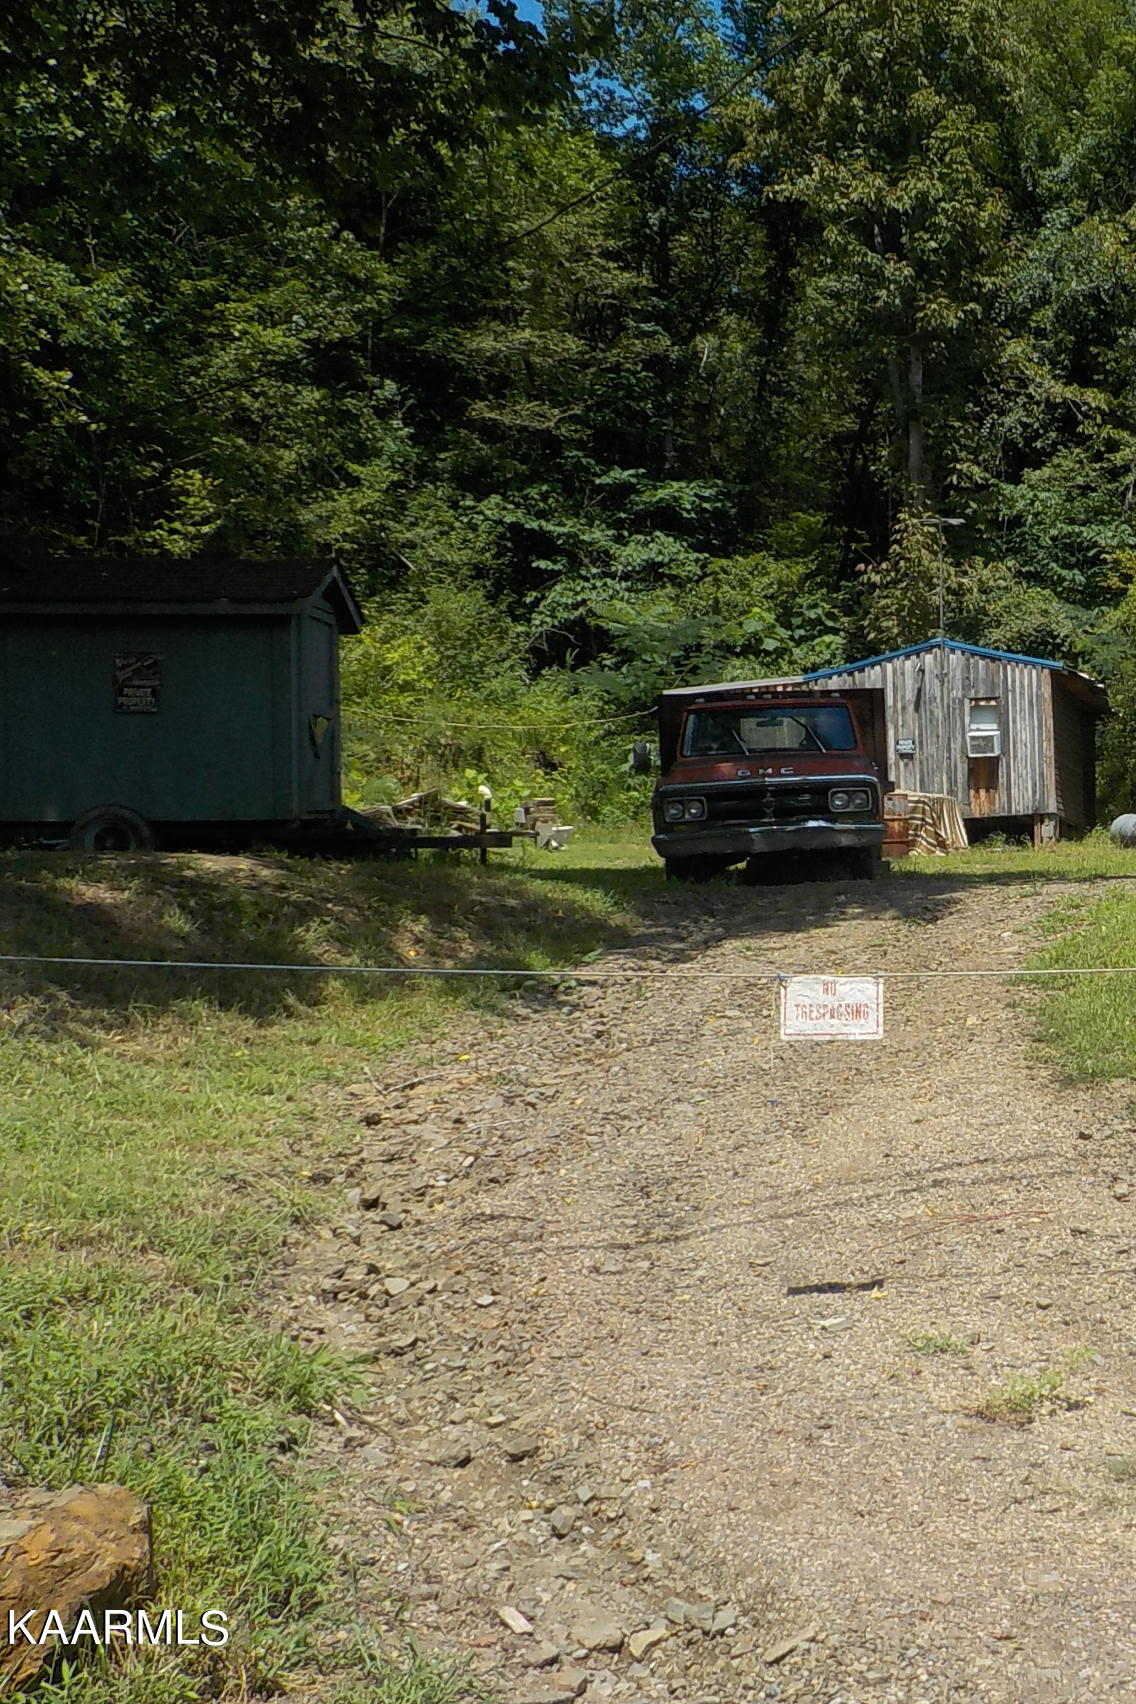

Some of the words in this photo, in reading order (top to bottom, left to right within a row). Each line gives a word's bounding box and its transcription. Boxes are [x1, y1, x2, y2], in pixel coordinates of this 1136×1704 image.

[737, 767, 794, 777] GMC
[822, 979, 837, 996] NO
[794, 1003, 870, 1021] TRESPASSING
